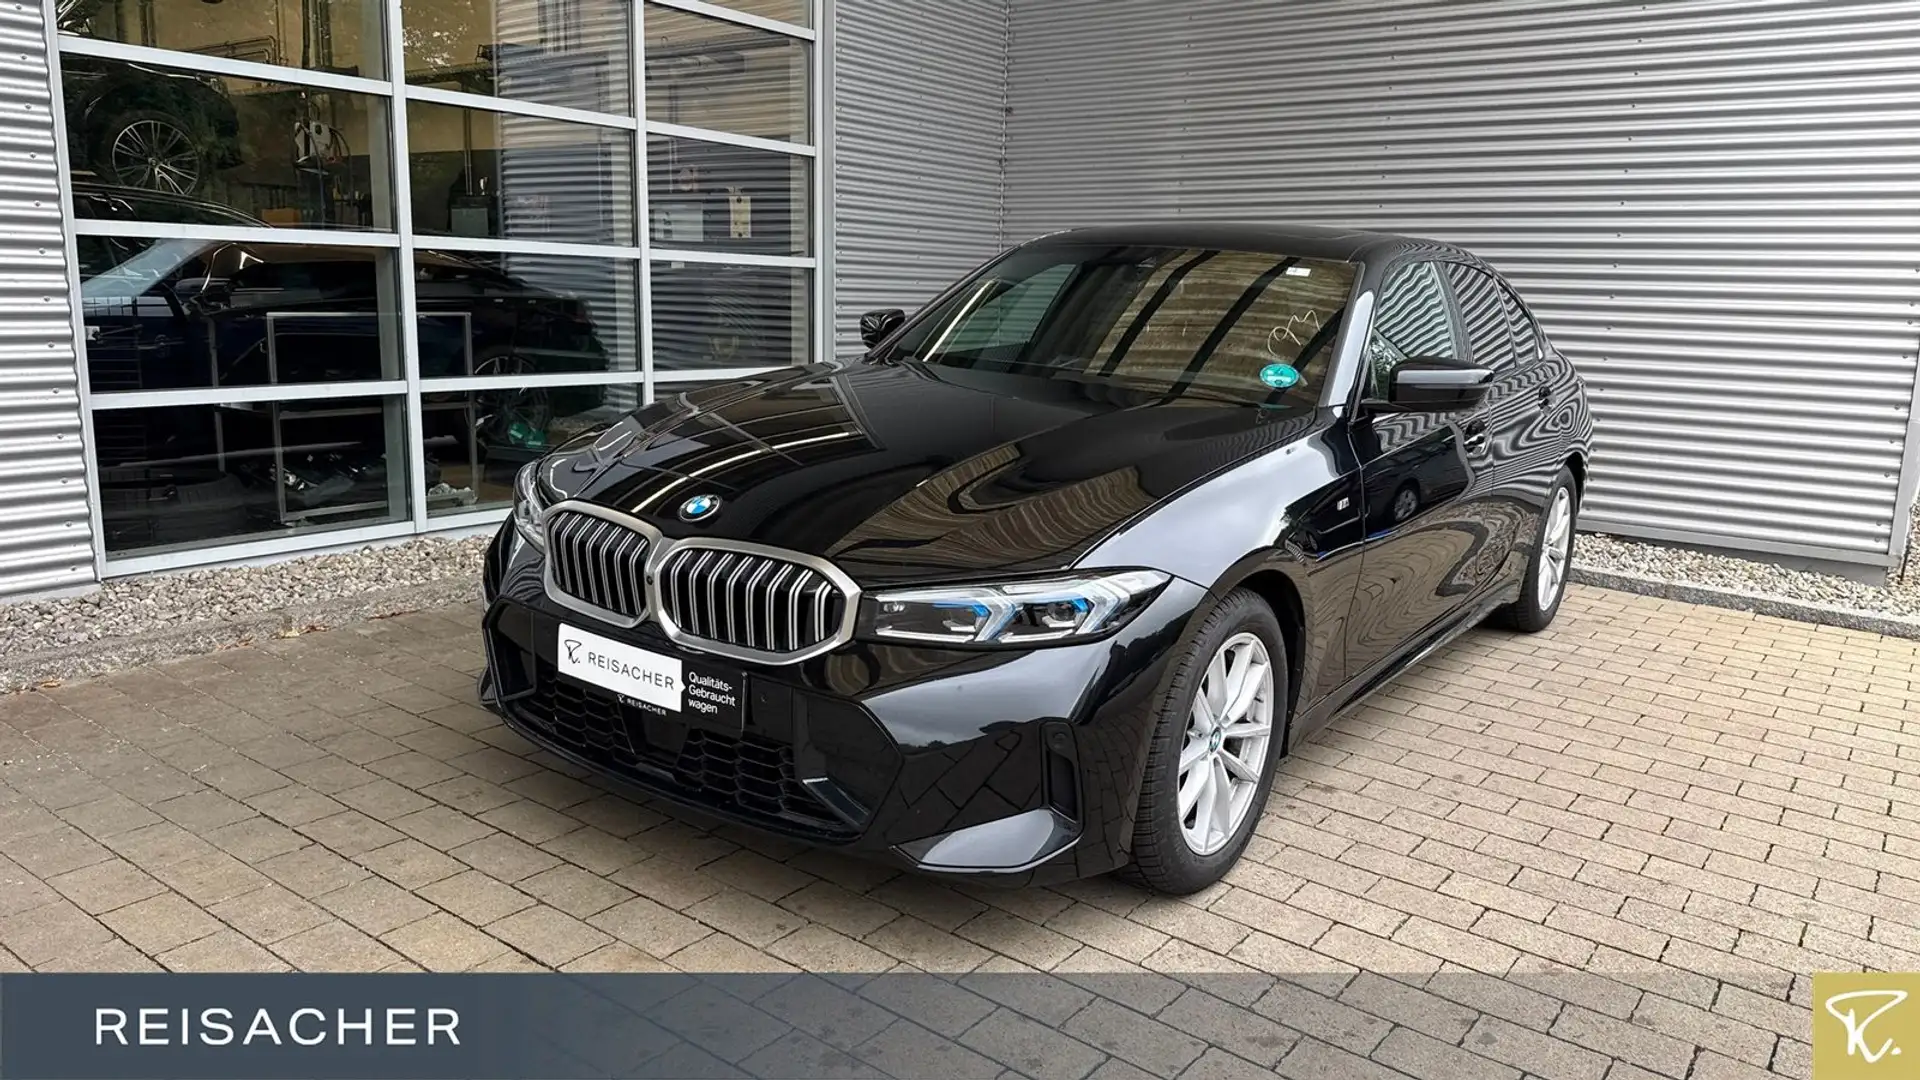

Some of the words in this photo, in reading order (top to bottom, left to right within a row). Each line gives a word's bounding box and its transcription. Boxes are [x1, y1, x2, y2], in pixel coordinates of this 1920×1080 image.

[587, 651, 675, 690] REISACHER
[688, 671, 733, 692] Qualitäts-
[688, 683, 736, 707] Gebraucht
[626, 698, 667, 716] REISACHER
[687, 698, 718, 714] wagen
